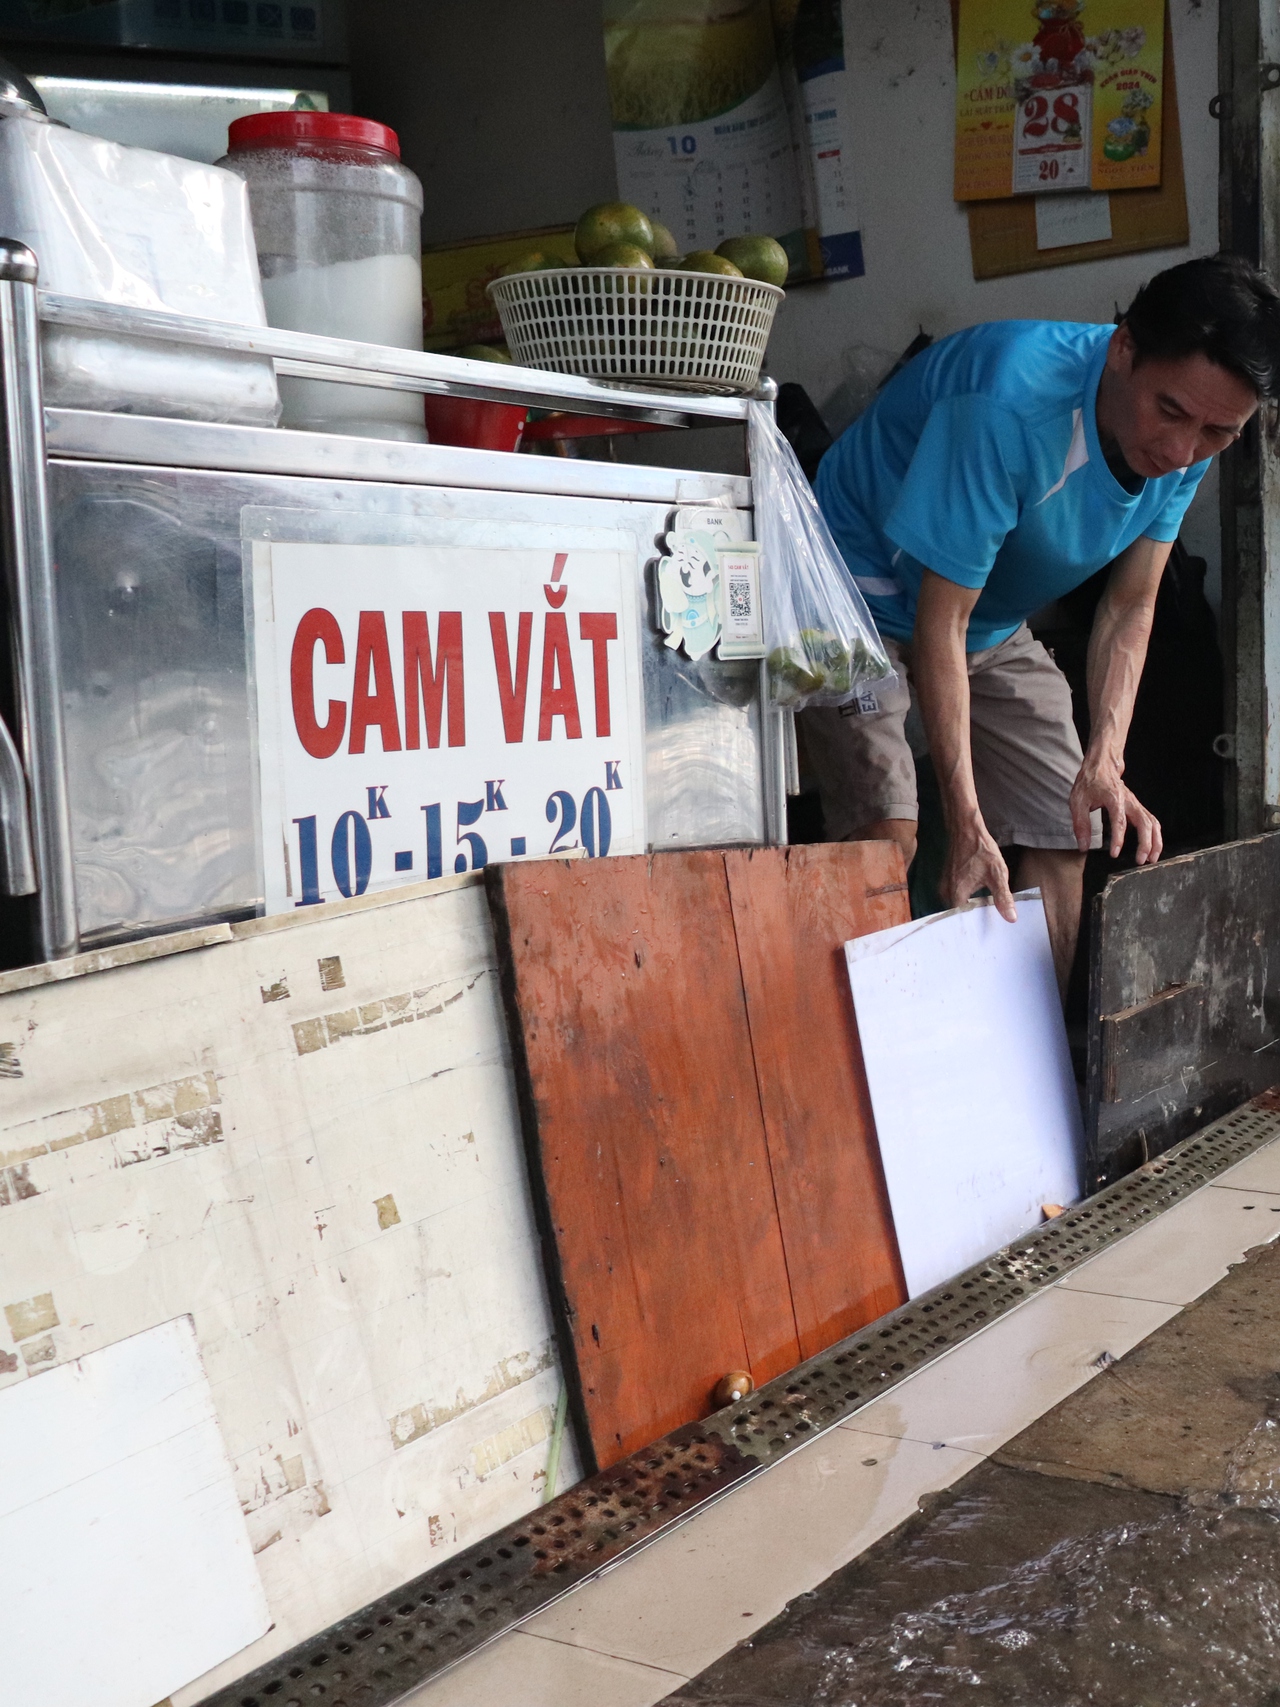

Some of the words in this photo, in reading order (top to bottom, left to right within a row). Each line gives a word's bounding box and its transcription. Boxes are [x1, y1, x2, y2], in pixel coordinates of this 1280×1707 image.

[1116, 81, 1140, 91] 2024
[1023, 93, 1080, 138] 28
[667, 135, 697, 155] 10
[1039, 159, 1059, 181] 20
[707, 518, 722, 526] BANK
[290, 607, 466, 759] CAM
[488, 553, 618, 744] VẮT
